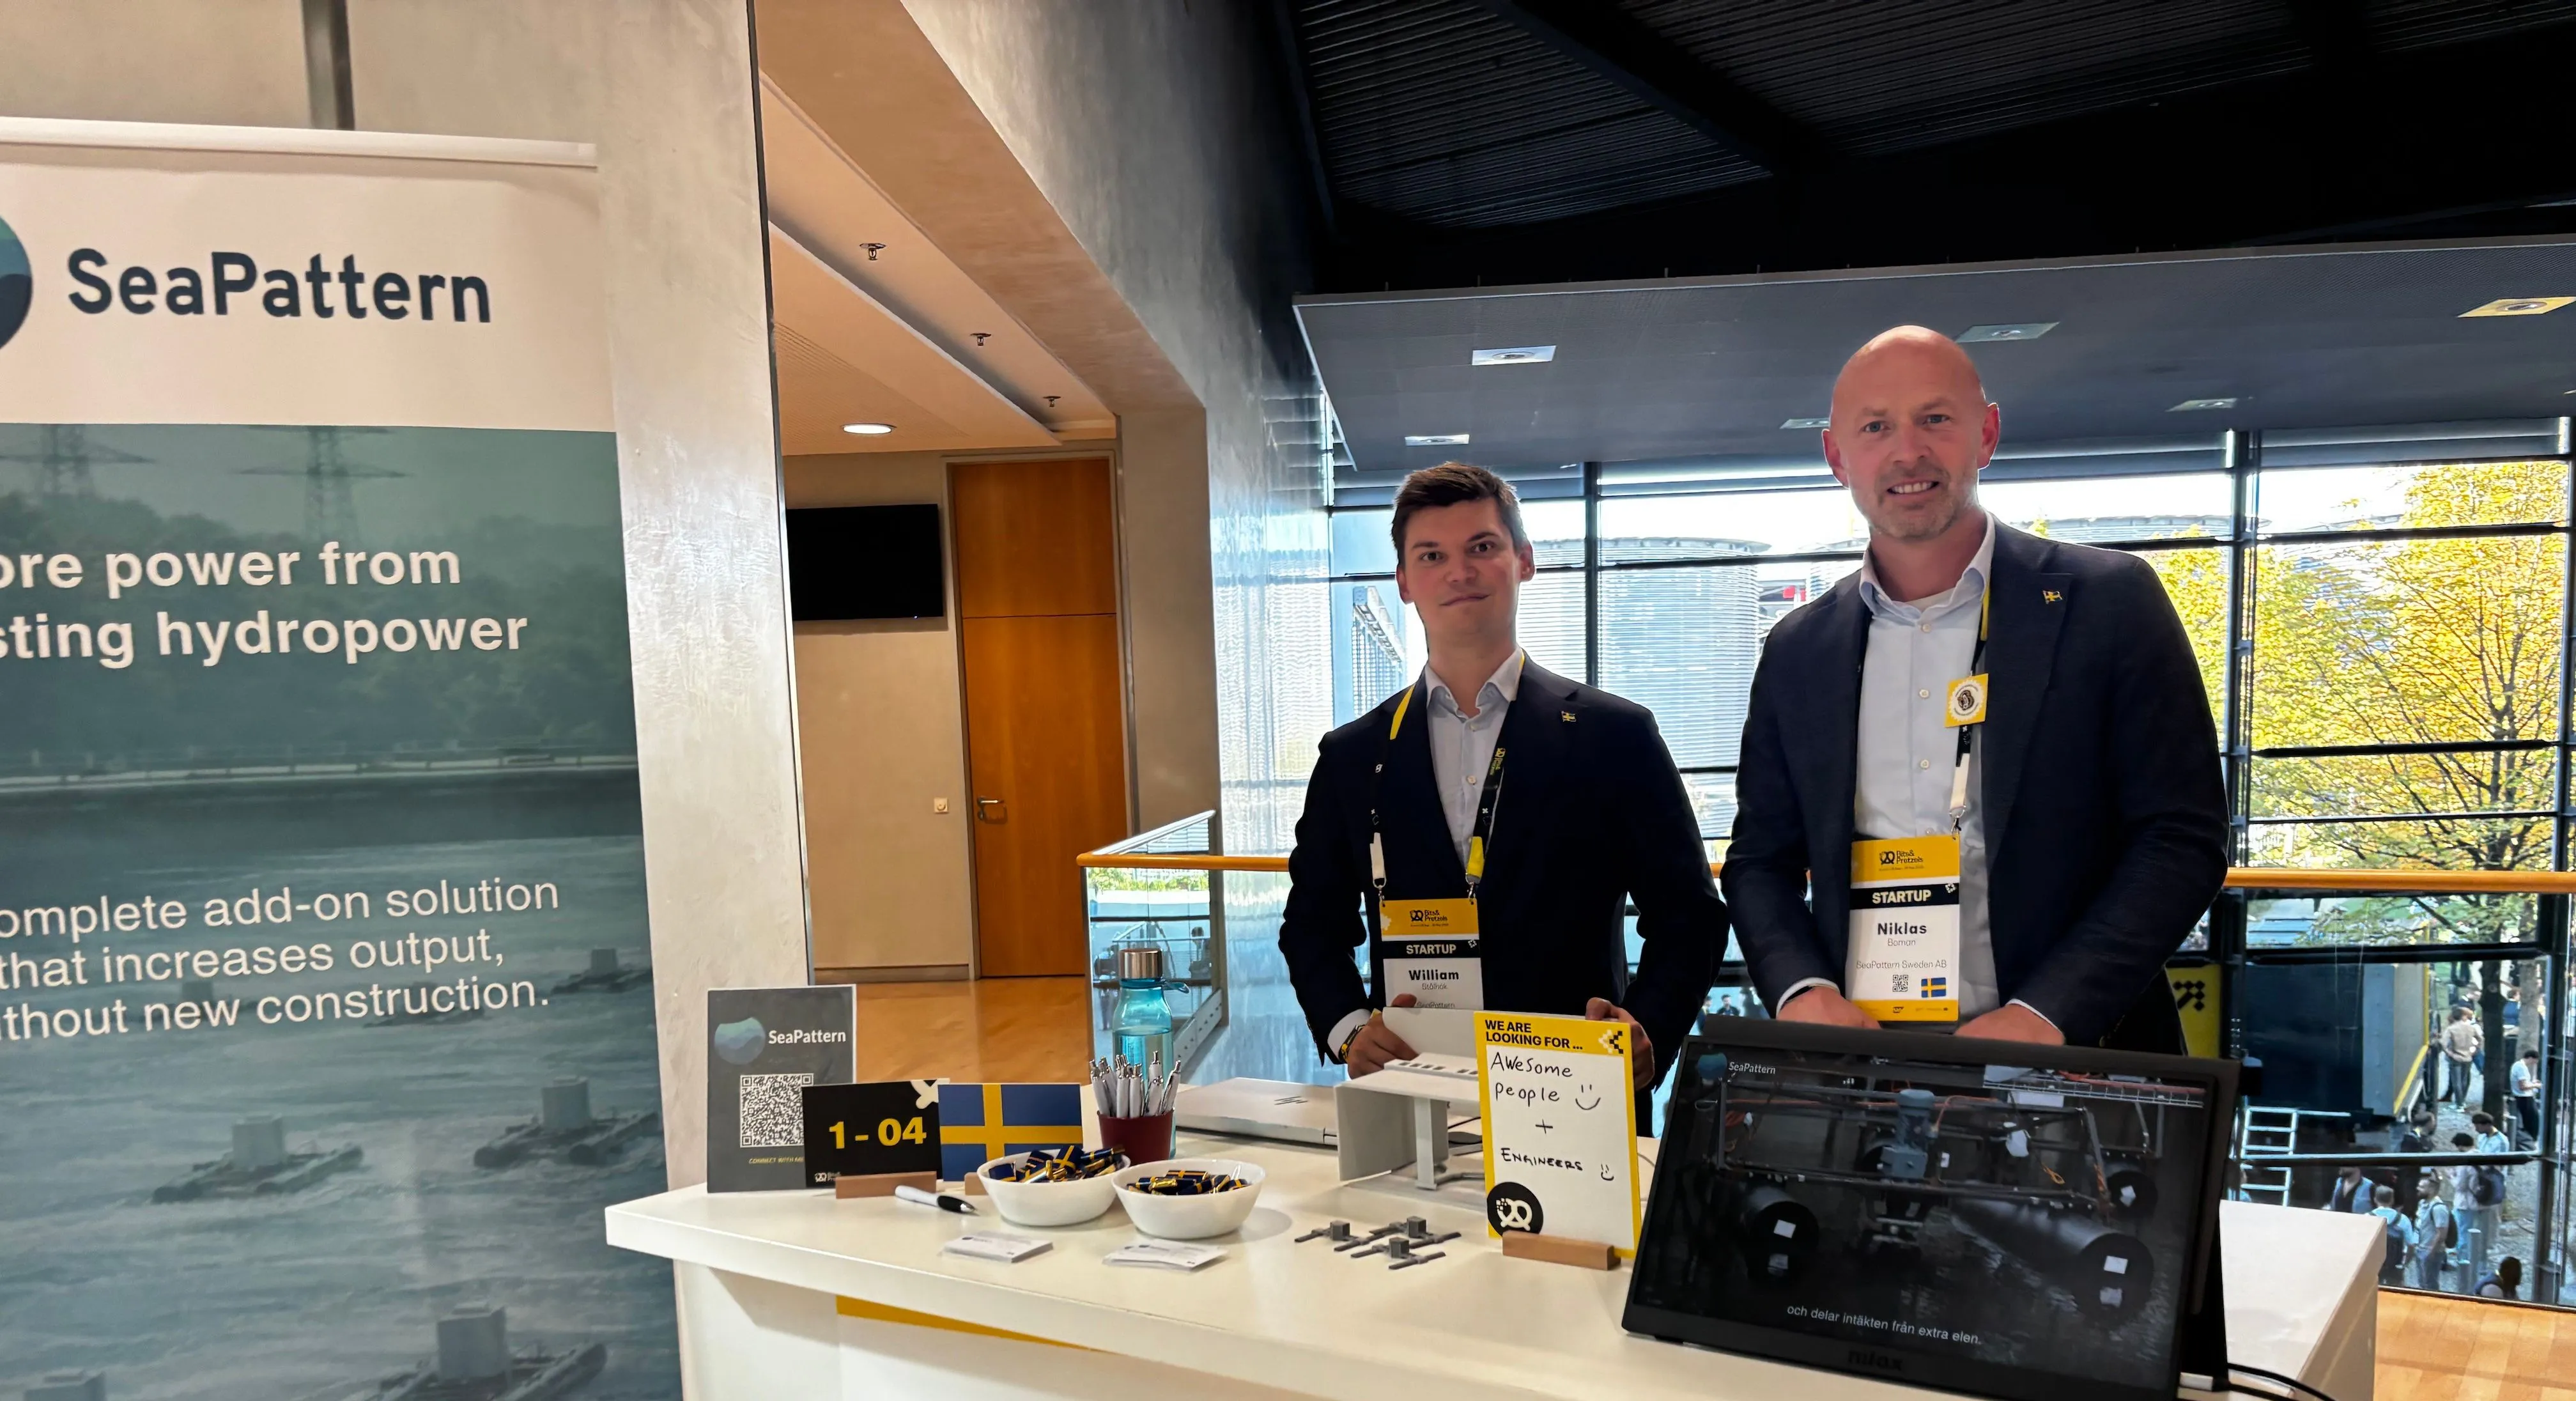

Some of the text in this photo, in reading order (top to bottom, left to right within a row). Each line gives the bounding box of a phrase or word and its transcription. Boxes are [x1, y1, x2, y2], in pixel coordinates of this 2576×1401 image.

[67, 247, 491, 323] SeaPattern
[105, 552, 300, 599] power
[318, 541, 460, 585] from
[157, 610, 527, 667] hydropower
[204, 886, 369, 926] add-on
[386, 878, 559, 917] solution
[1872, 889, 1932, 904] STARTUP
[1877, 922, 1927, 935] Niklas
[1406, 944, 1457, 955] STARTUP
[1887, 938, 1916, 947] Boman
[102, 942, 334, 983] increases
[350, 929, 504, 973] output,
[1856, 959, 1947, 969] SeaPattern Sweden AB
[1408, 969, 1459, 980] William
[144, 998, 240, 1032] new
[256, 976, 549, 1024] construction.
[1485, 1019, 1532, 1033] WE ARE
[768, 1030, 846, 1044] SeaPattern
[1486, 1032, 1541, 1046] LOOKING
[1545, 1037, 1570, 1049] FOR
[1728, 1062, 1775, 1074] SeaPattern
[829, 1121, 845, 1149] 1
[878, 1117, 927, 1147] 04
[1787, 1306, 1982, 1345] och delar intäkten från extra elen.
